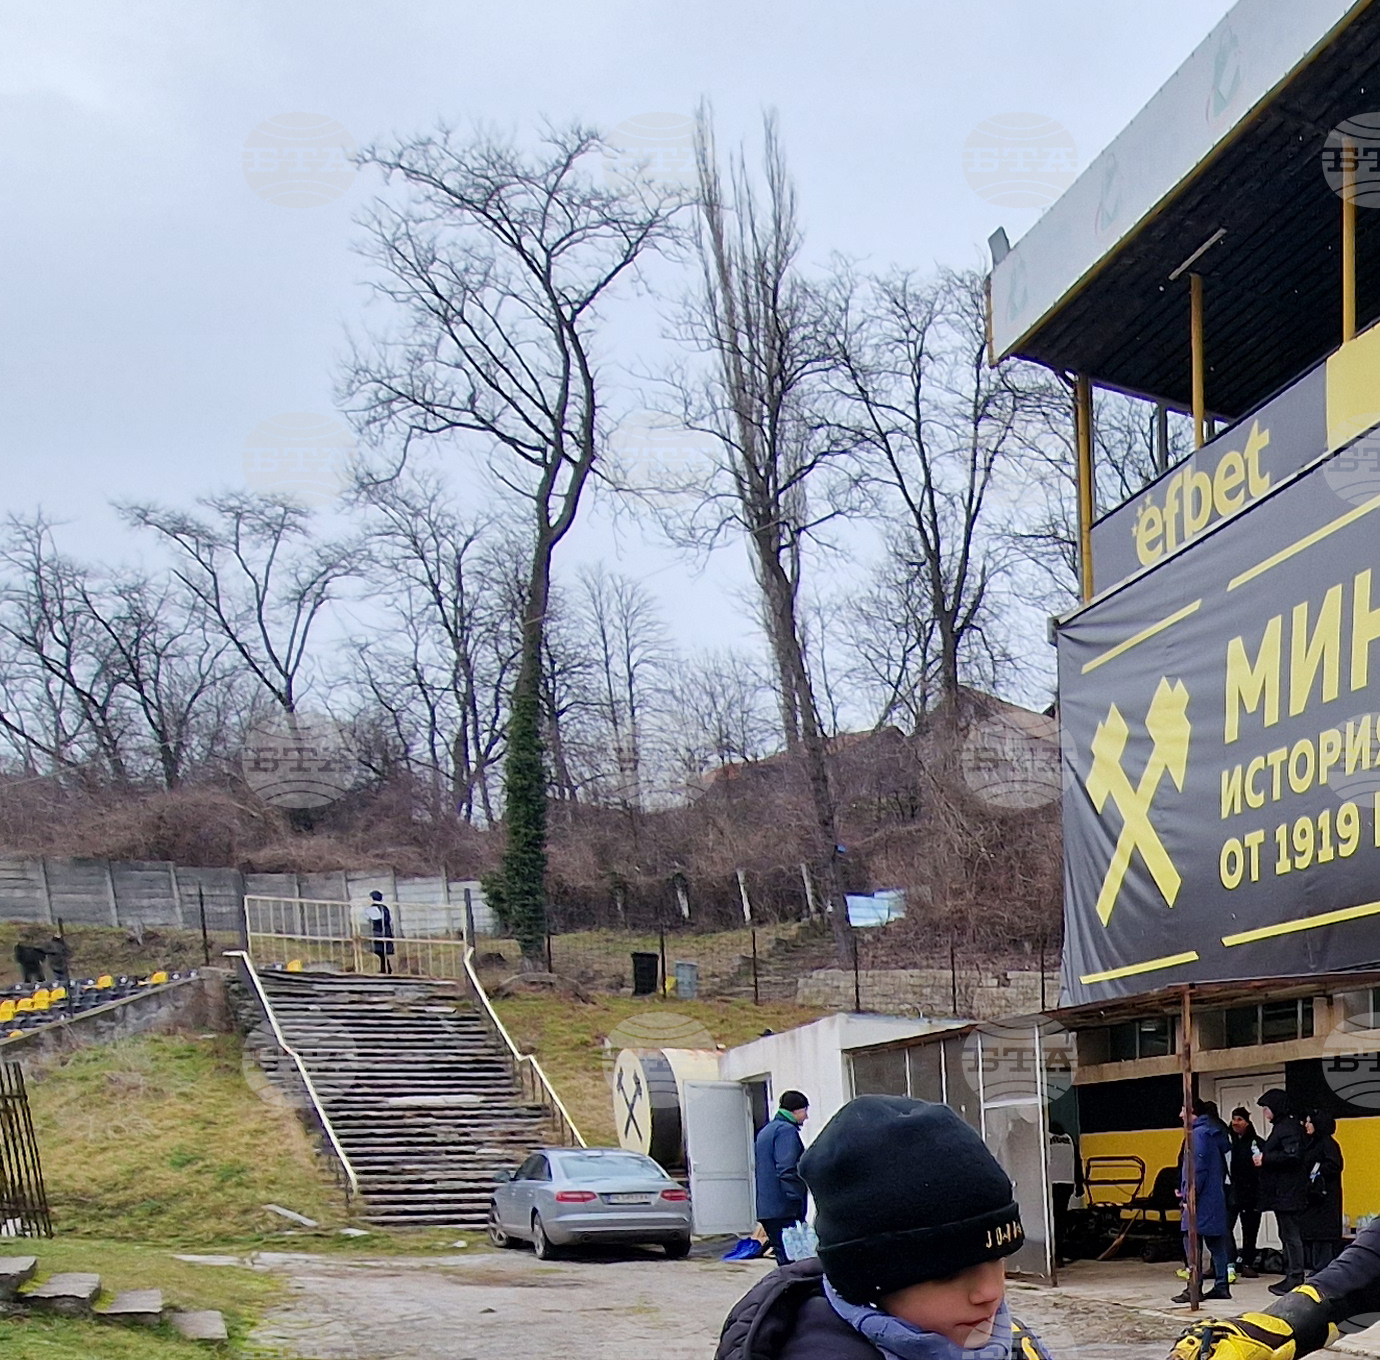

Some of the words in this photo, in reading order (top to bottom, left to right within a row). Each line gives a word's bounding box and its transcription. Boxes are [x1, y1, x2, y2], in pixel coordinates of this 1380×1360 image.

[1136, 419, 1270, 567] efbet
[1219, 829, 1265, 890] ОТ
[1275, 801, 1360, 876] 1919
